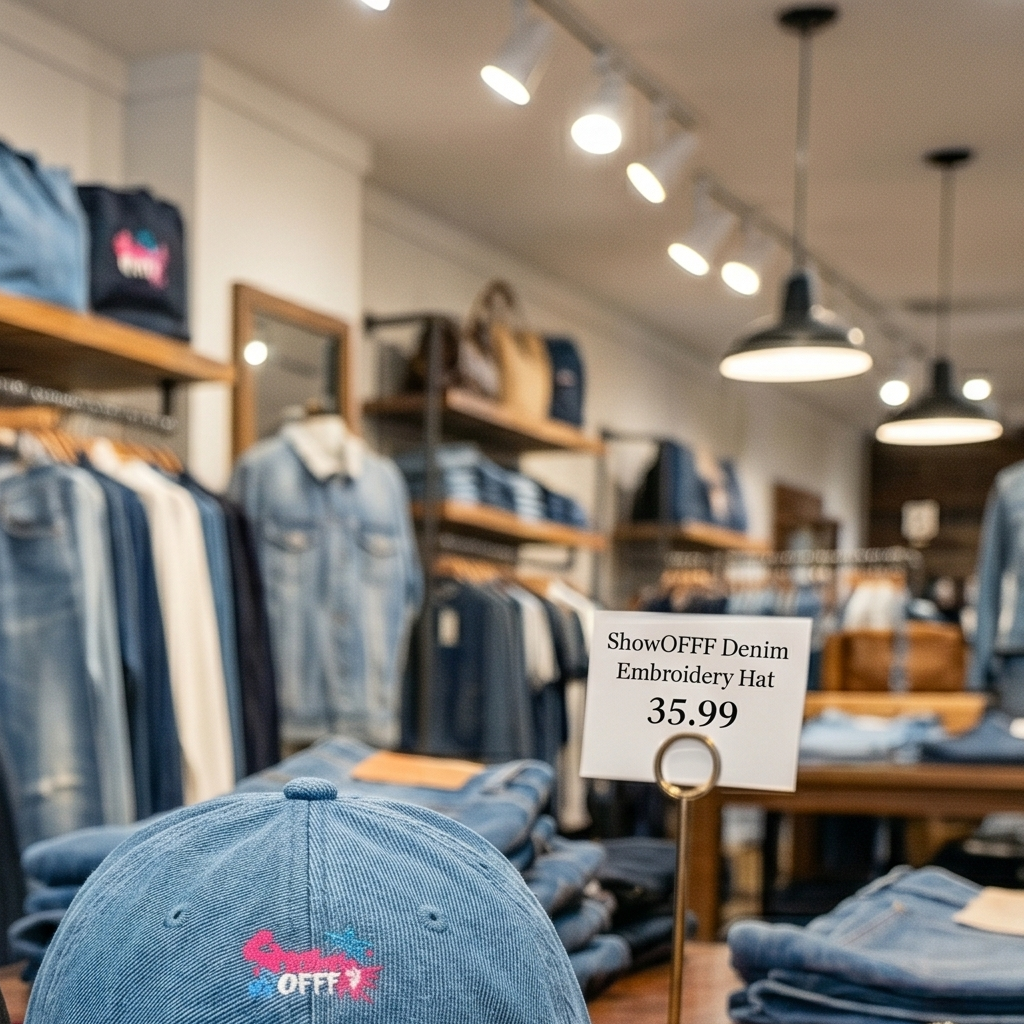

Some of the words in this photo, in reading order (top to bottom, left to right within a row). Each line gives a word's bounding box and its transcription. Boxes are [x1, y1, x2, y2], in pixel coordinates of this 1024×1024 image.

[607, 632, 717, 656] ShowOFFF
[721, 639, 789, 660] Denim
[616, 662, 734, 690] Embroidery
[738, 669, 775, 688] Hat
[647, 697, 738, 729] 35.99
[277, 972, 341, 996] OFFF
